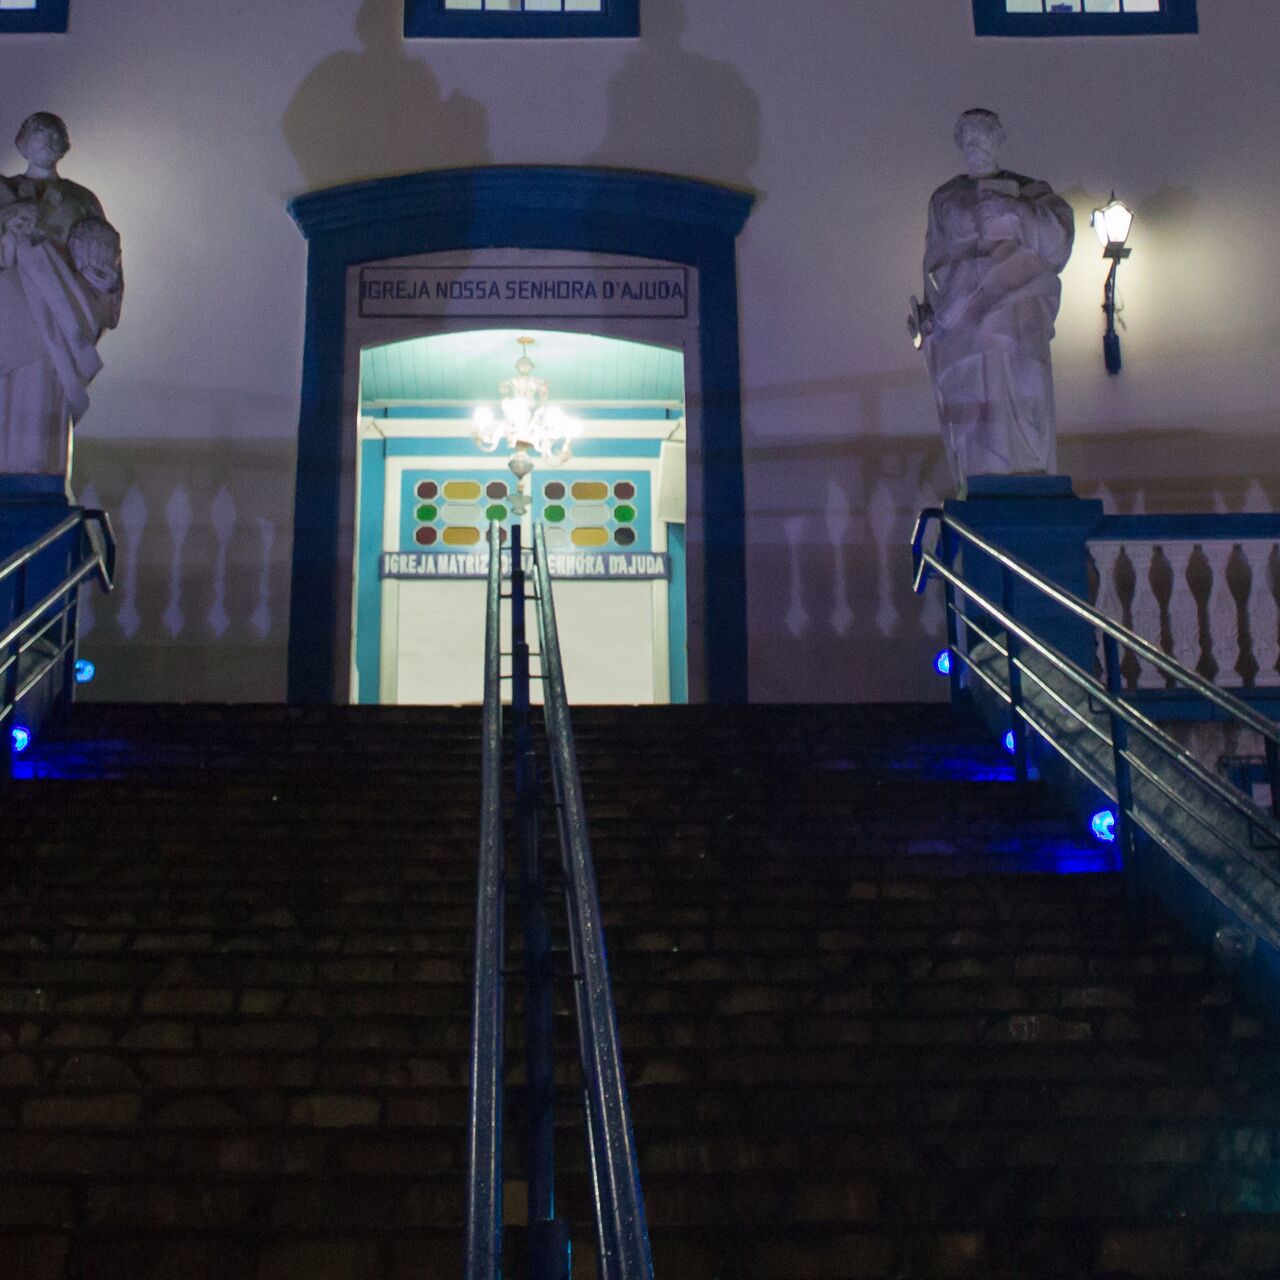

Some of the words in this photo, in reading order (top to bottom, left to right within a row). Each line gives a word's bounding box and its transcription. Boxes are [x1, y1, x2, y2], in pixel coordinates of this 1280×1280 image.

[360, 279, 431, 300] IGREJA
[436, 279, 502, 300] NOSSA
[505, 279, 598, 300] SENHORA
[602, 278, 685, 300] D'AJUDA
[383, 553, 436, 575] IGREJA
[437, 553, 489, 575] MATRIZ
[546, 553, 605, 576] ENHORA
